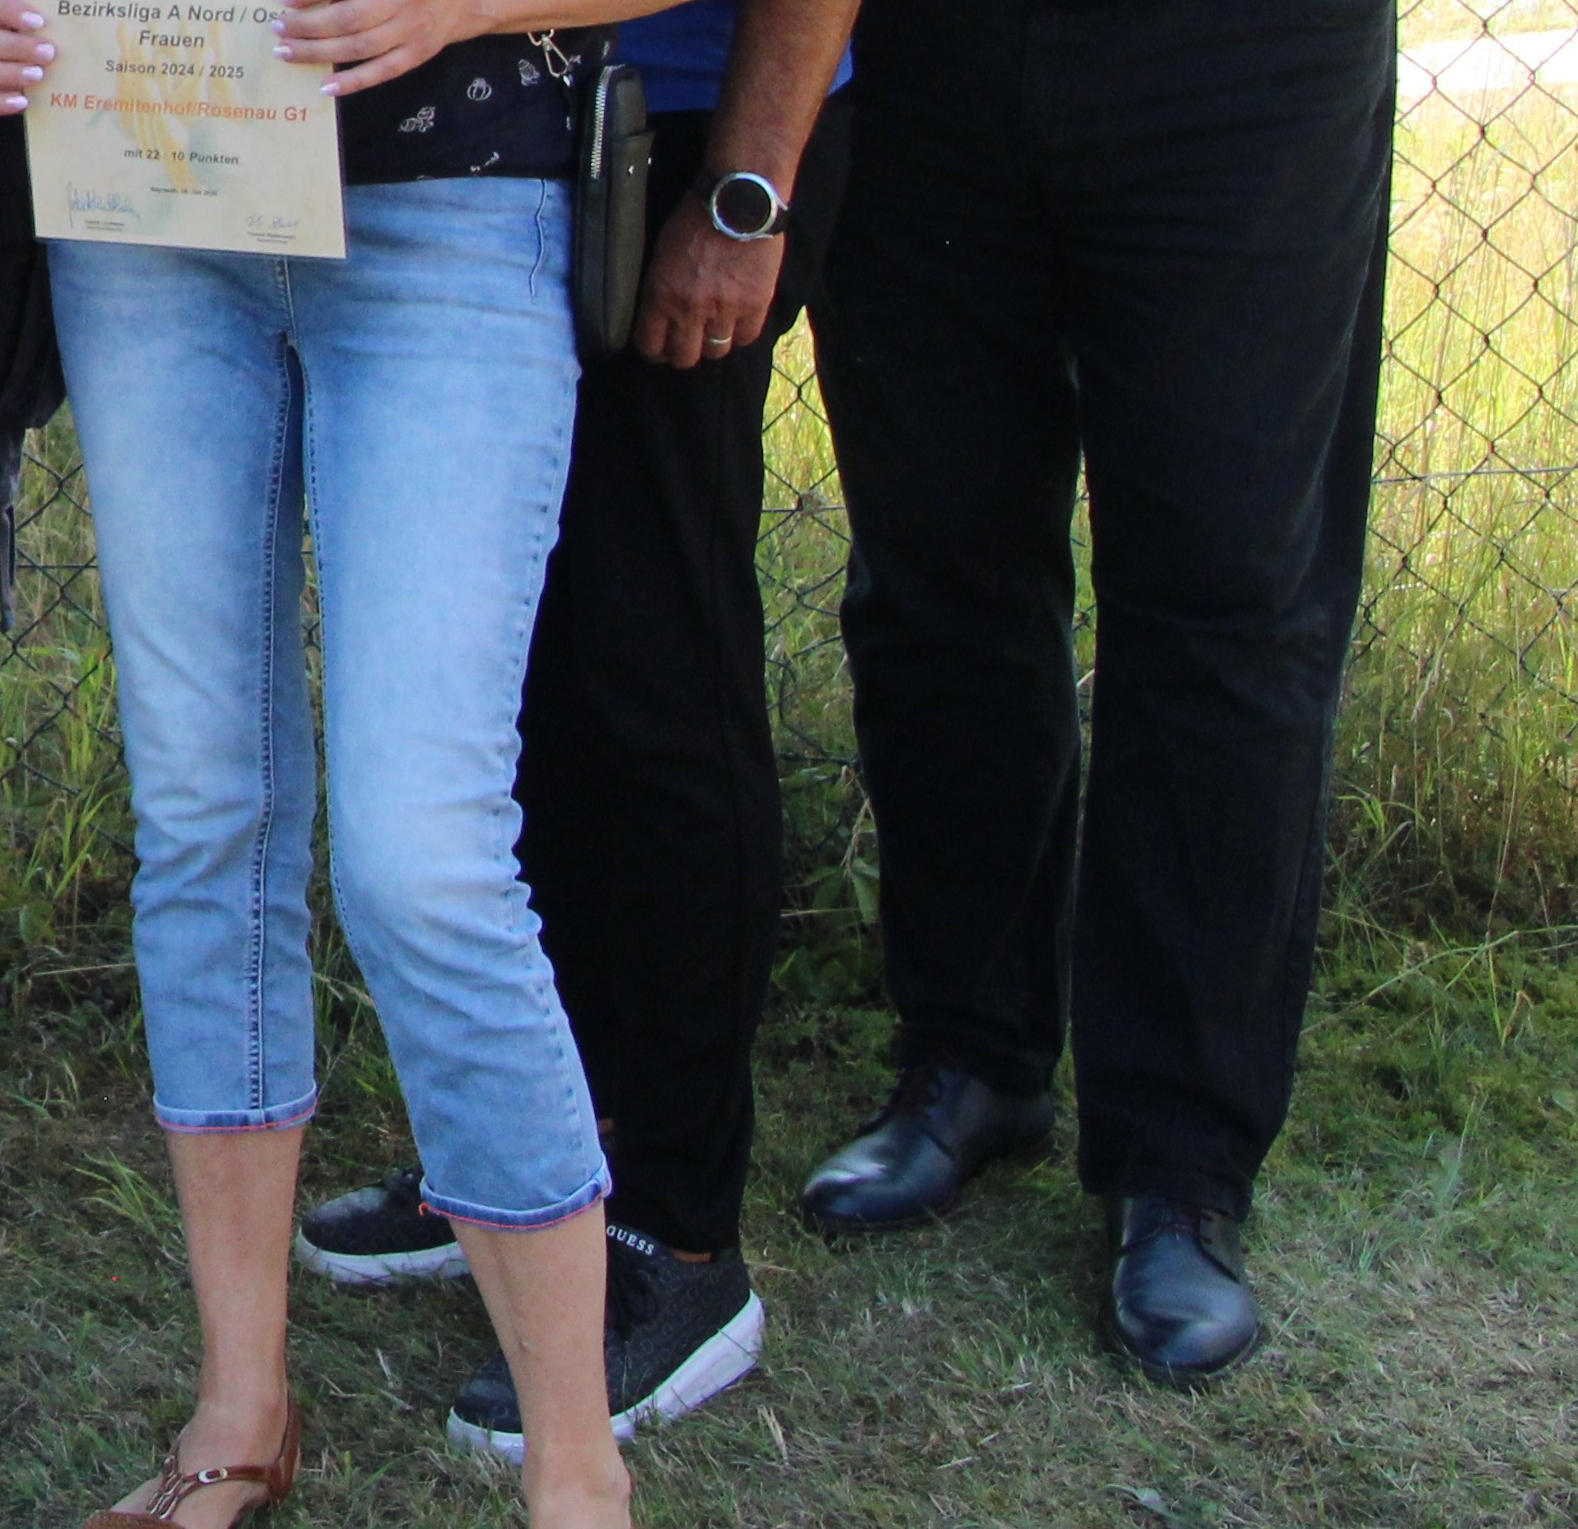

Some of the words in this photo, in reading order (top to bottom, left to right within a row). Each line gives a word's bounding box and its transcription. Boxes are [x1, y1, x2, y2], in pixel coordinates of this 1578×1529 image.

[58, 0, 161, 21] Bezirksliga
[167, 5, 181, 20] A
[187, 5, 234, 23] Nord
[253, 7, 286, 25] Os
[139, 31, 205, 49] Frauen
[105, 60, 155, 75] Saison
[161, 63, 198, 77] 2024
[209, 64, 244, 79] 2025
[50, 94, 78, 110] KM
[284, 106, 308, 122] G1
[124, 147, 143, 159] mit
[146, 149, 160, 160] 22
[172, 151, 185, 161] 10
[189, 151, 239, 165] Punkten
[606, 1225, 654, 1255] GUESS
